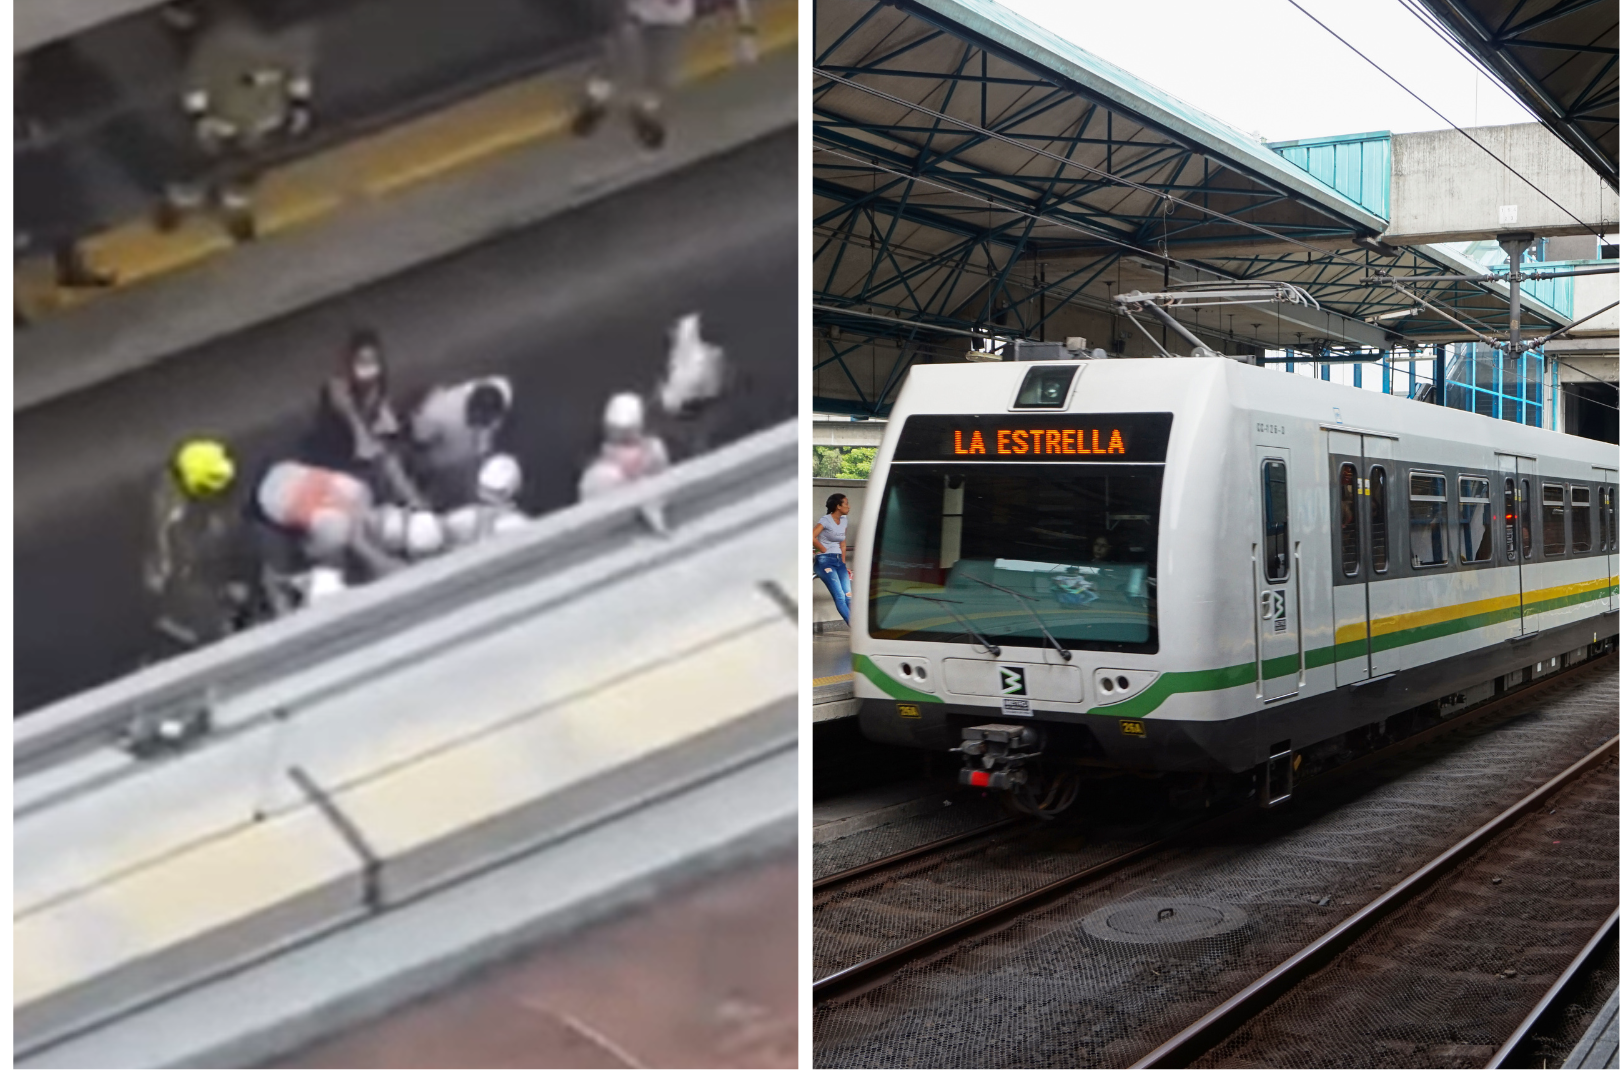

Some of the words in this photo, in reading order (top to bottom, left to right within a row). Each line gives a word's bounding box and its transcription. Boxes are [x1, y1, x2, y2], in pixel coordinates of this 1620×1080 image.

[954, 430, 986, 454] LA
[997, 429, 1126, 454] ESTRELLA
[1121, 722, 1143, 734] 26A
